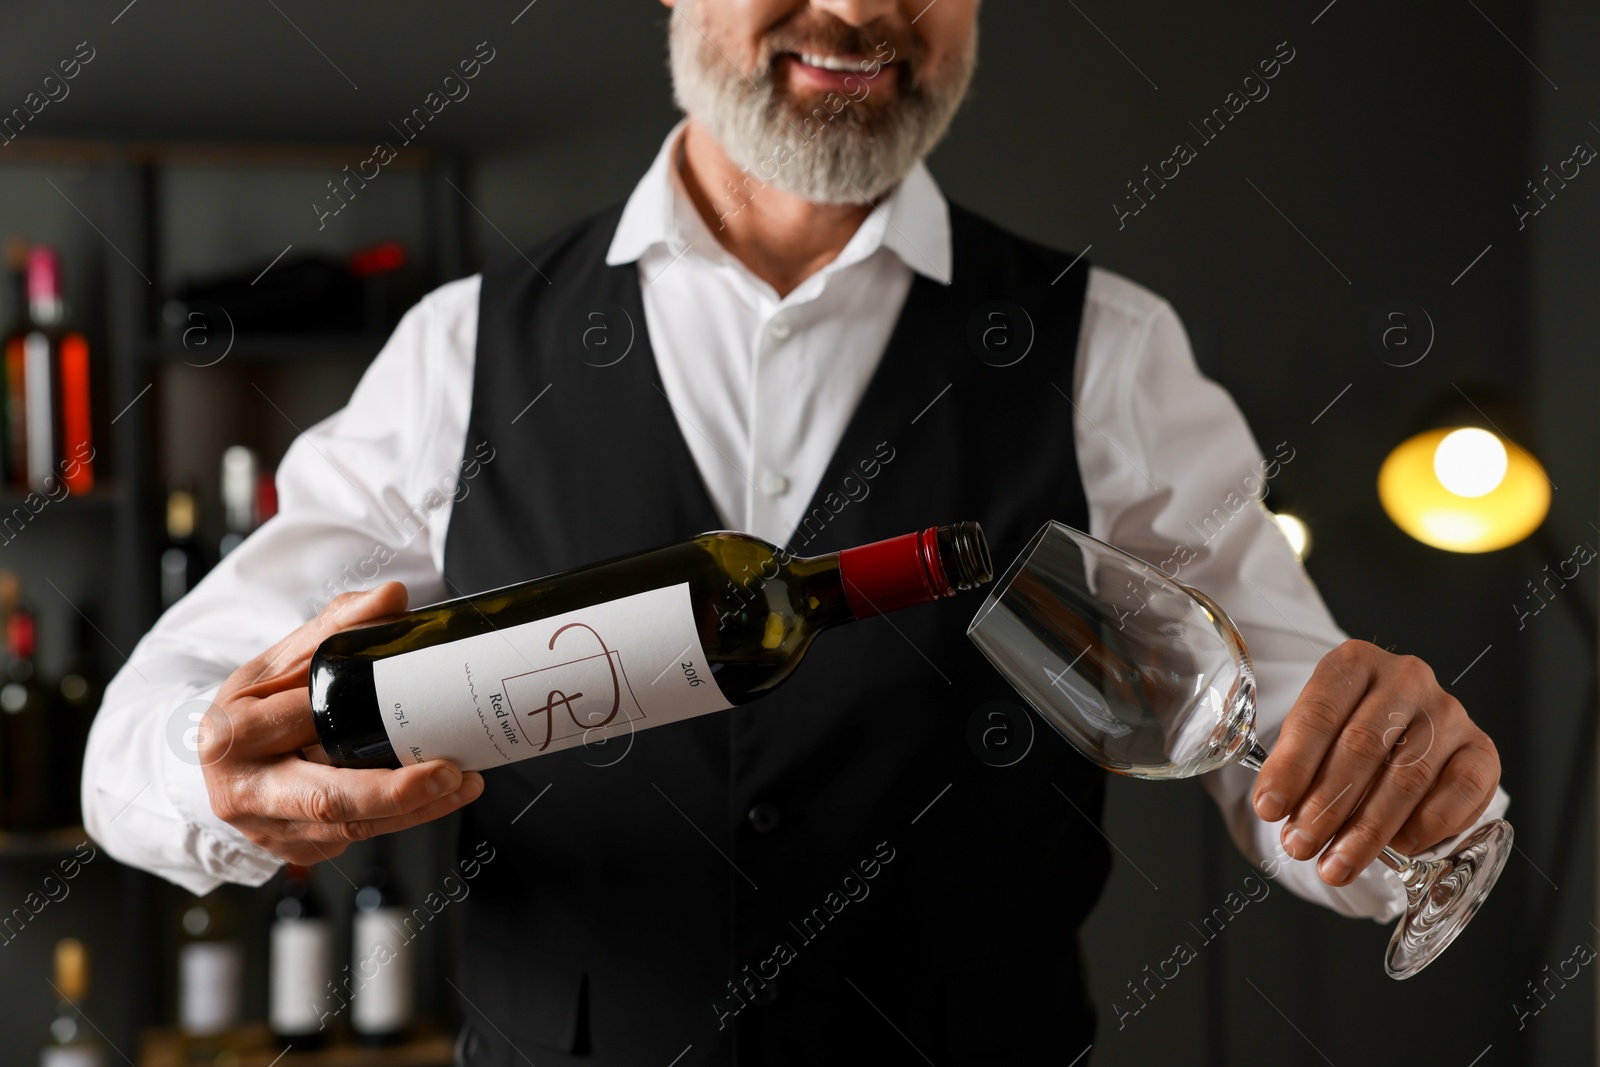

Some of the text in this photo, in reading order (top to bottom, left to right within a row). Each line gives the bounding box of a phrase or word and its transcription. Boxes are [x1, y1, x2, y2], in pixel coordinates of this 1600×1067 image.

[681, 661, 705, 687] 2016
[394, 702, 409, 728] 0.75 L
[489, 693, 519, 745] Red wine
